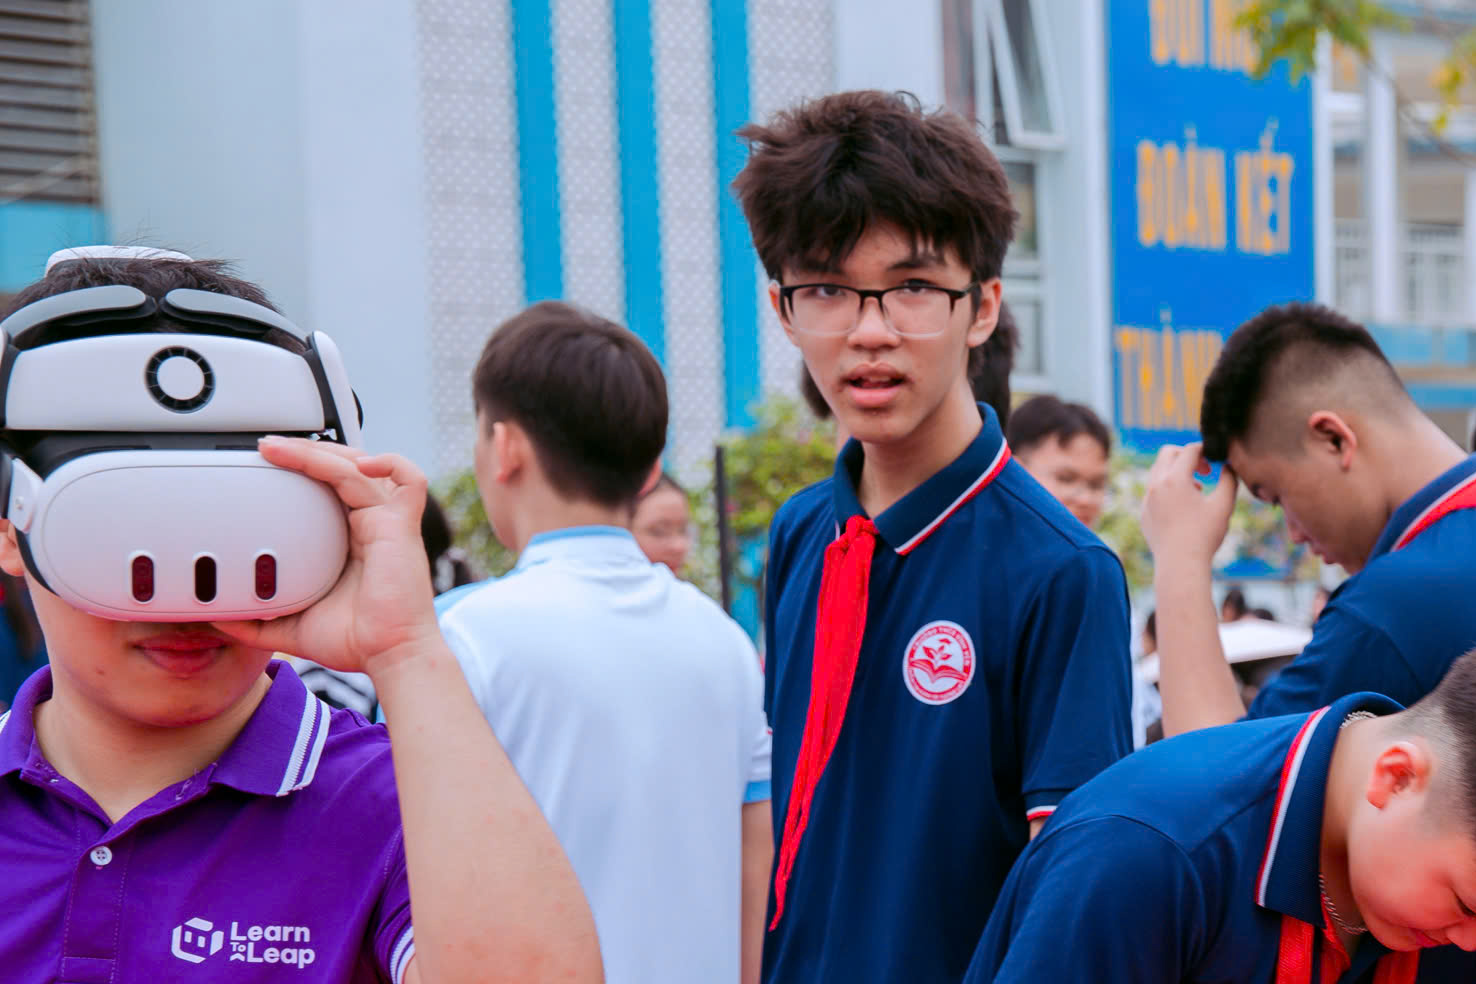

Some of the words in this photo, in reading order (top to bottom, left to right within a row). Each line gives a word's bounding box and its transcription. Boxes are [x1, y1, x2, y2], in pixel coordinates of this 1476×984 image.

[1137, 123, 1226, 248] ĐOÀN
[1235, 117, 1294, 254] KẾT
[230, 921, 311, 942] Learn
[230, 942, 246, 952] To
[247, 942, 315, 968] Leap
